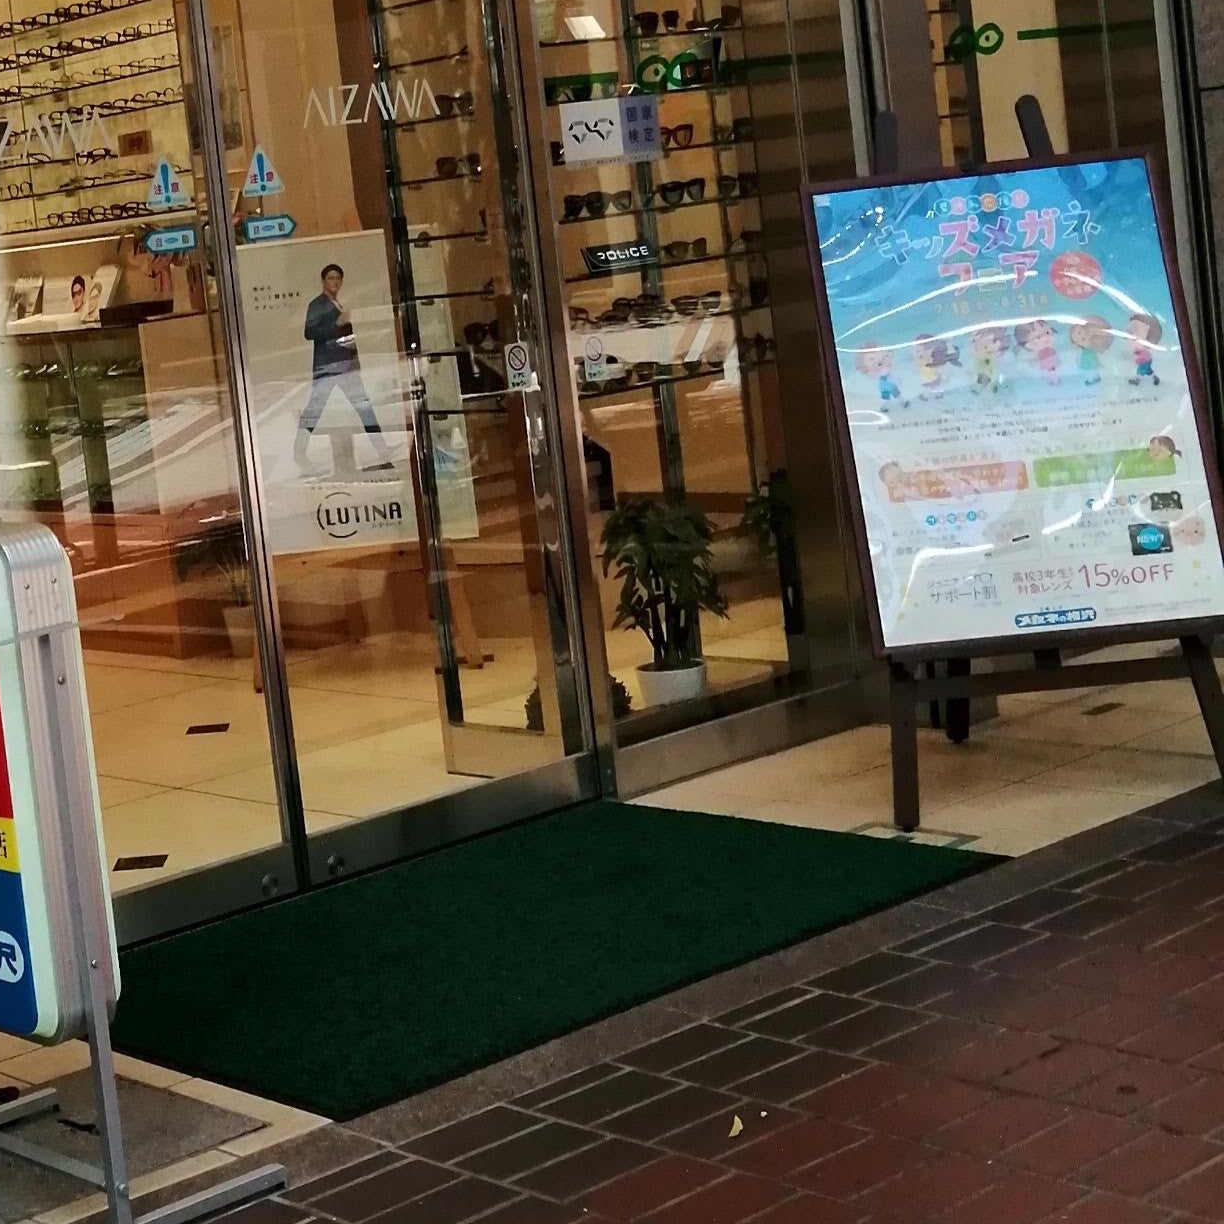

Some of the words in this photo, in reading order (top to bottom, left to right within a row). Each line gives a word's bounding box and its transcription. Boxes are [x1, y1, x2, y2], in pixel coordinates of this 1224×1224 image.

[303, 78, 441, 128] AIZAWA
[325, 501, 403, 526] LUTINA
[1077, 563, 1175, 589] 15%OFF
